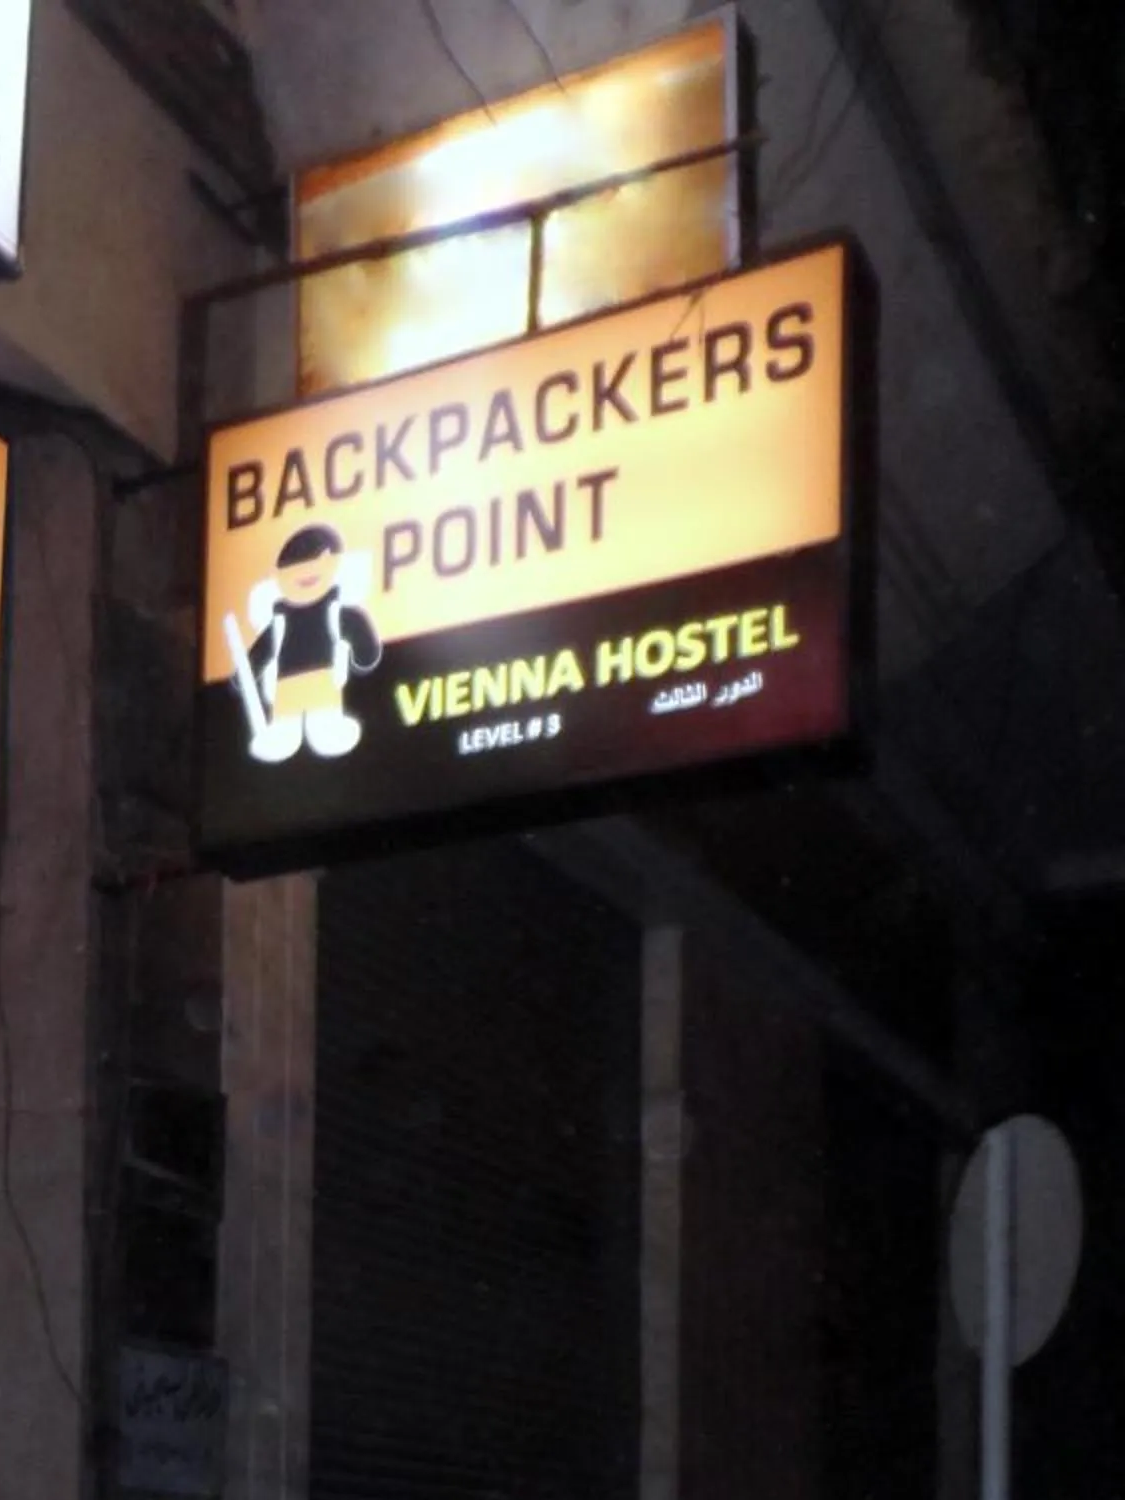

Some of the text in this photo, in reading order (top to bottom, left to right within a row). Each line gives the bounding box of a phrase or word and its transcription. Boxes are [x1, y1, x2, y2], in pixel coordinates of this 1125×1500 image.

[225, 300, 816, 532] BACKPACKERS
[380, 465, 620, 594] POINT
[393, 603, 802, 728] VIENNA HOSTEL
[458, 722, 524, 755] LEVEL
[544, 713, 564, 739] 3
